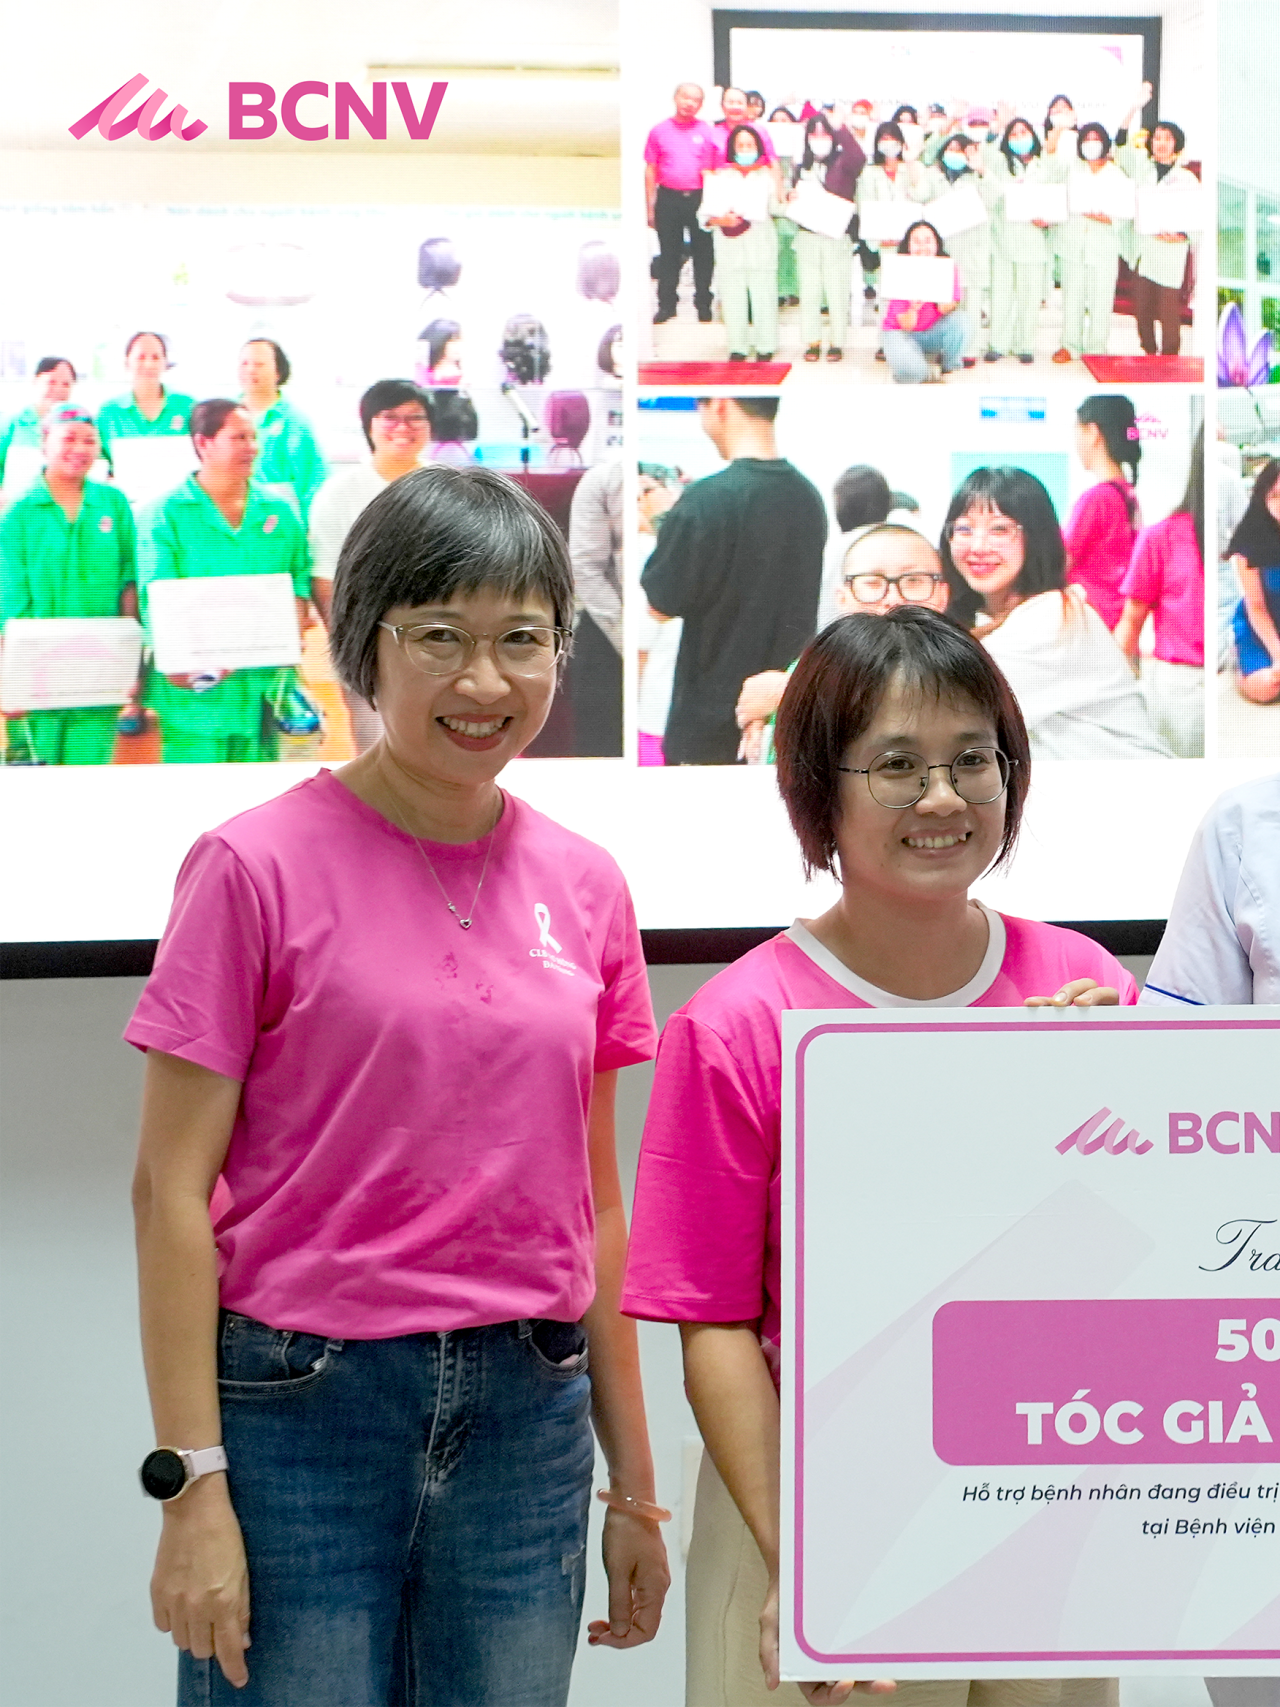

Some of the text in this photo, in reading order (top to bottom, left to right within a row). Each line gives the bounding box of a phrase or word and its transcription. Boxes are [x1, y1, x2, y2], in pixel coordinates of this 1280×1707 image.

[1127, 427, 1168, 440] BCNV
[1016, 1389, 1144, 1445] TÓC
[1163, 1383, 1273, 1444] GIẢ
[963, 1483, 989, 1501] Hỗ
[996, 1487, 1025, 1505] trợ
[1031, 1484, 1081, 1505] bệnh
[1089, 1484, 1141, 1500] nhân
[1148, 1483, 1201, 1503] đang
[1207, 1482, 1250, 1499] điều
[1257, 1483, 1279, 1502] trị
[1142, 1519, 1169, 1539] tại
[1175, 1518, 1227, 1538] Bệnh
[1235, 1518, 1276, 1538] viện
